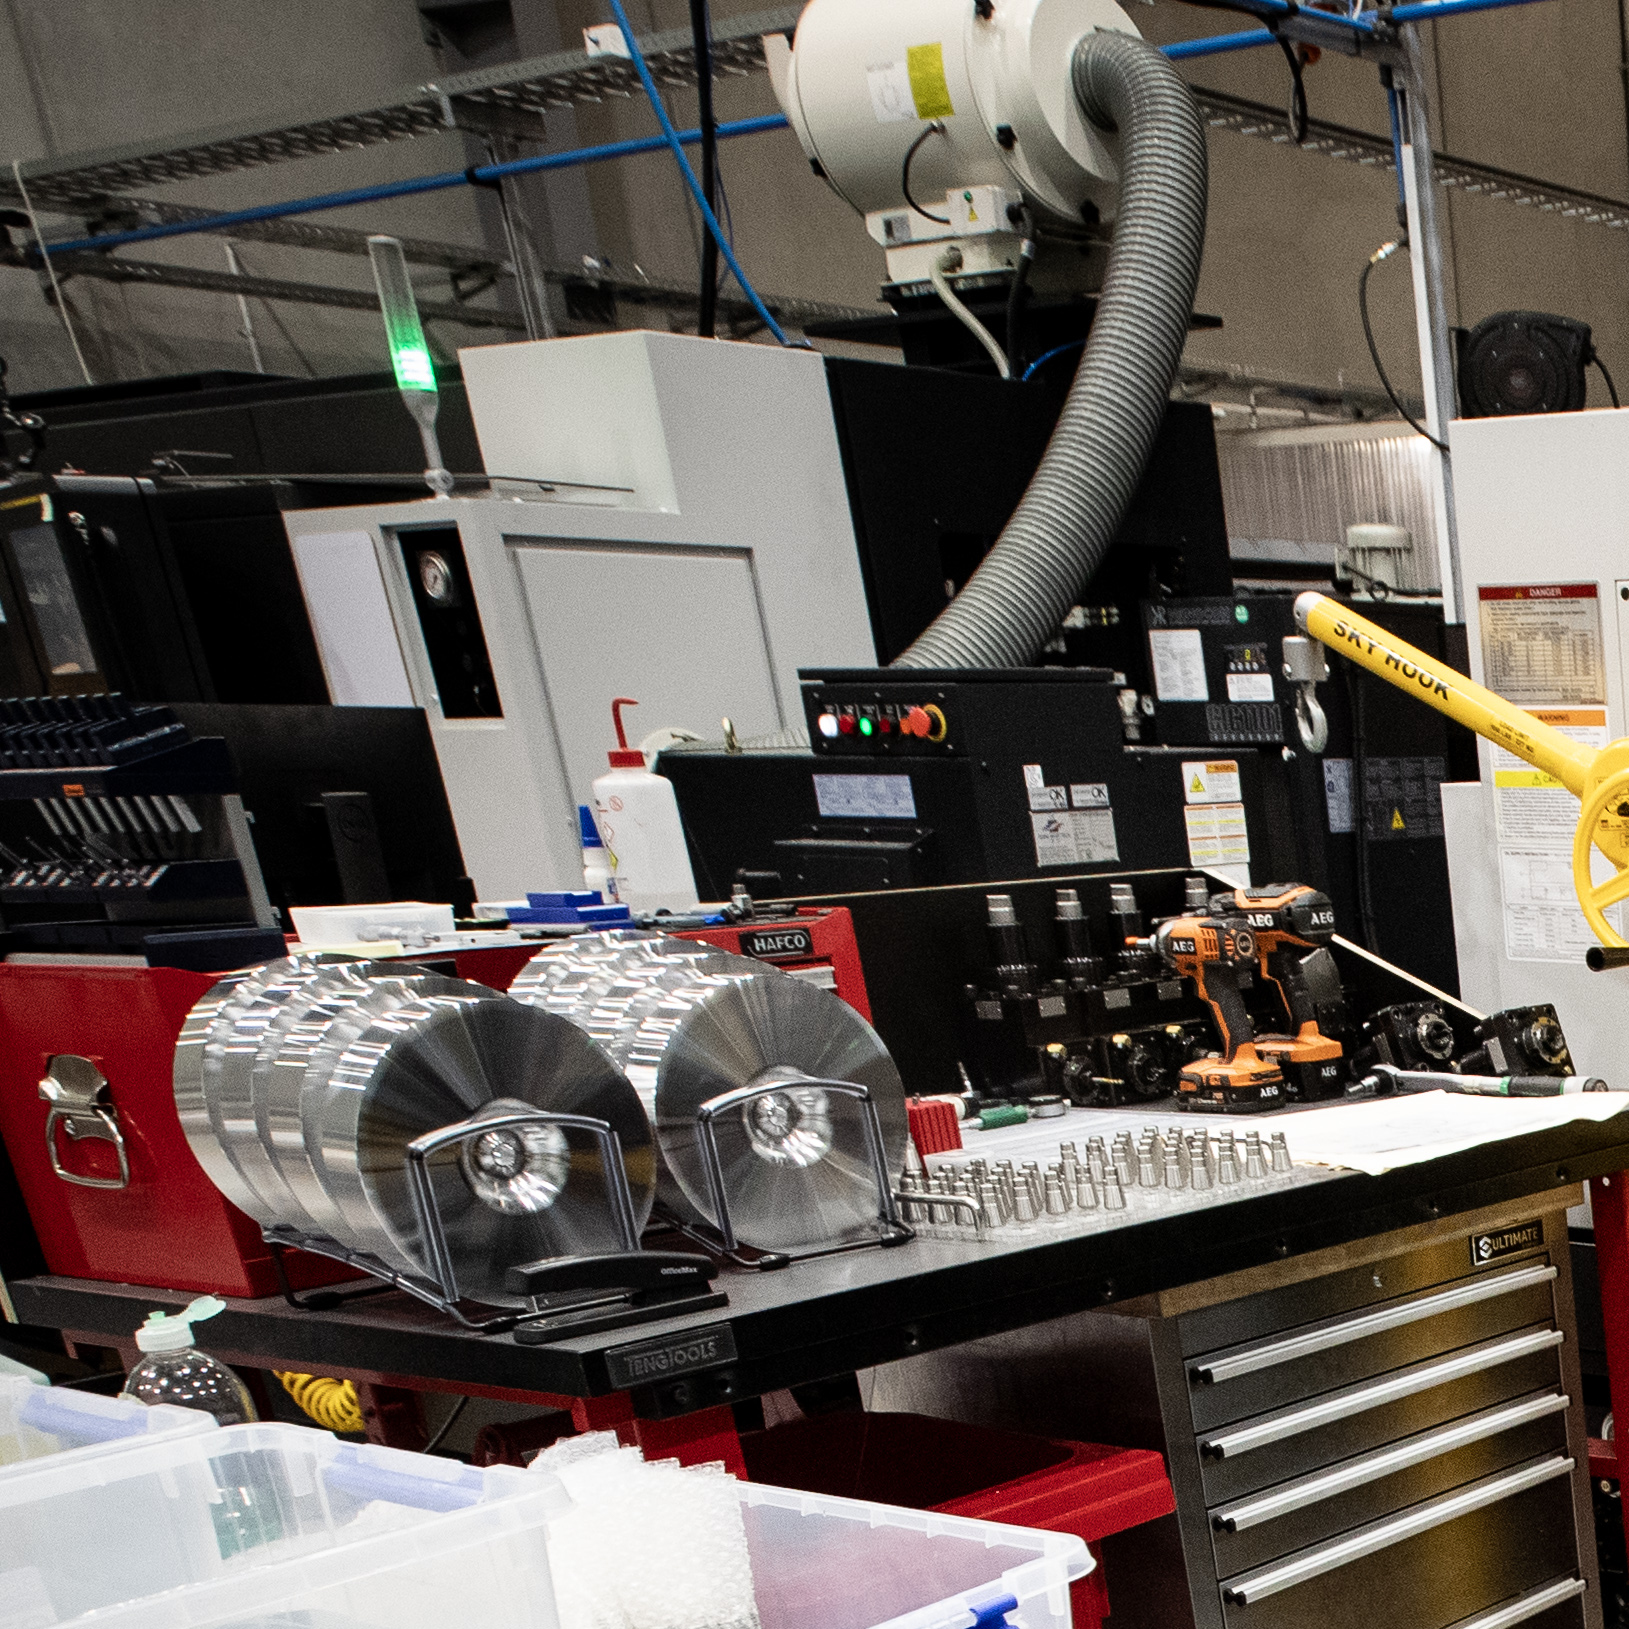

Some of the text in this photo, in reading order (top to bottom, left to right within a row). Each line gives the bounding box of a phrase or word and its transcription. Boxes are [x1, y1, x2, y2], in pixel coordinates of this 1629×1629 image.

[1529, 587, 1562, 598] DANGER
[1334, 620, 1382, 656] SKY
[1385, 650, 1453, 701] HOOK
[1247, 914, 1274, 928] AEG
[1310, 912, 1335, 925] AEG
[753, 934, 806, 952] HAFCO
[1172, 941, 1195, 953] AEG
[1321, 1065, 1337, 1077] AEG
[1259, 1085, 1279, 1099] AEG
[1492, 1226, 1539, 1251] ULTIMATE
[661, 1266, 698, 1275] OfficeMax
